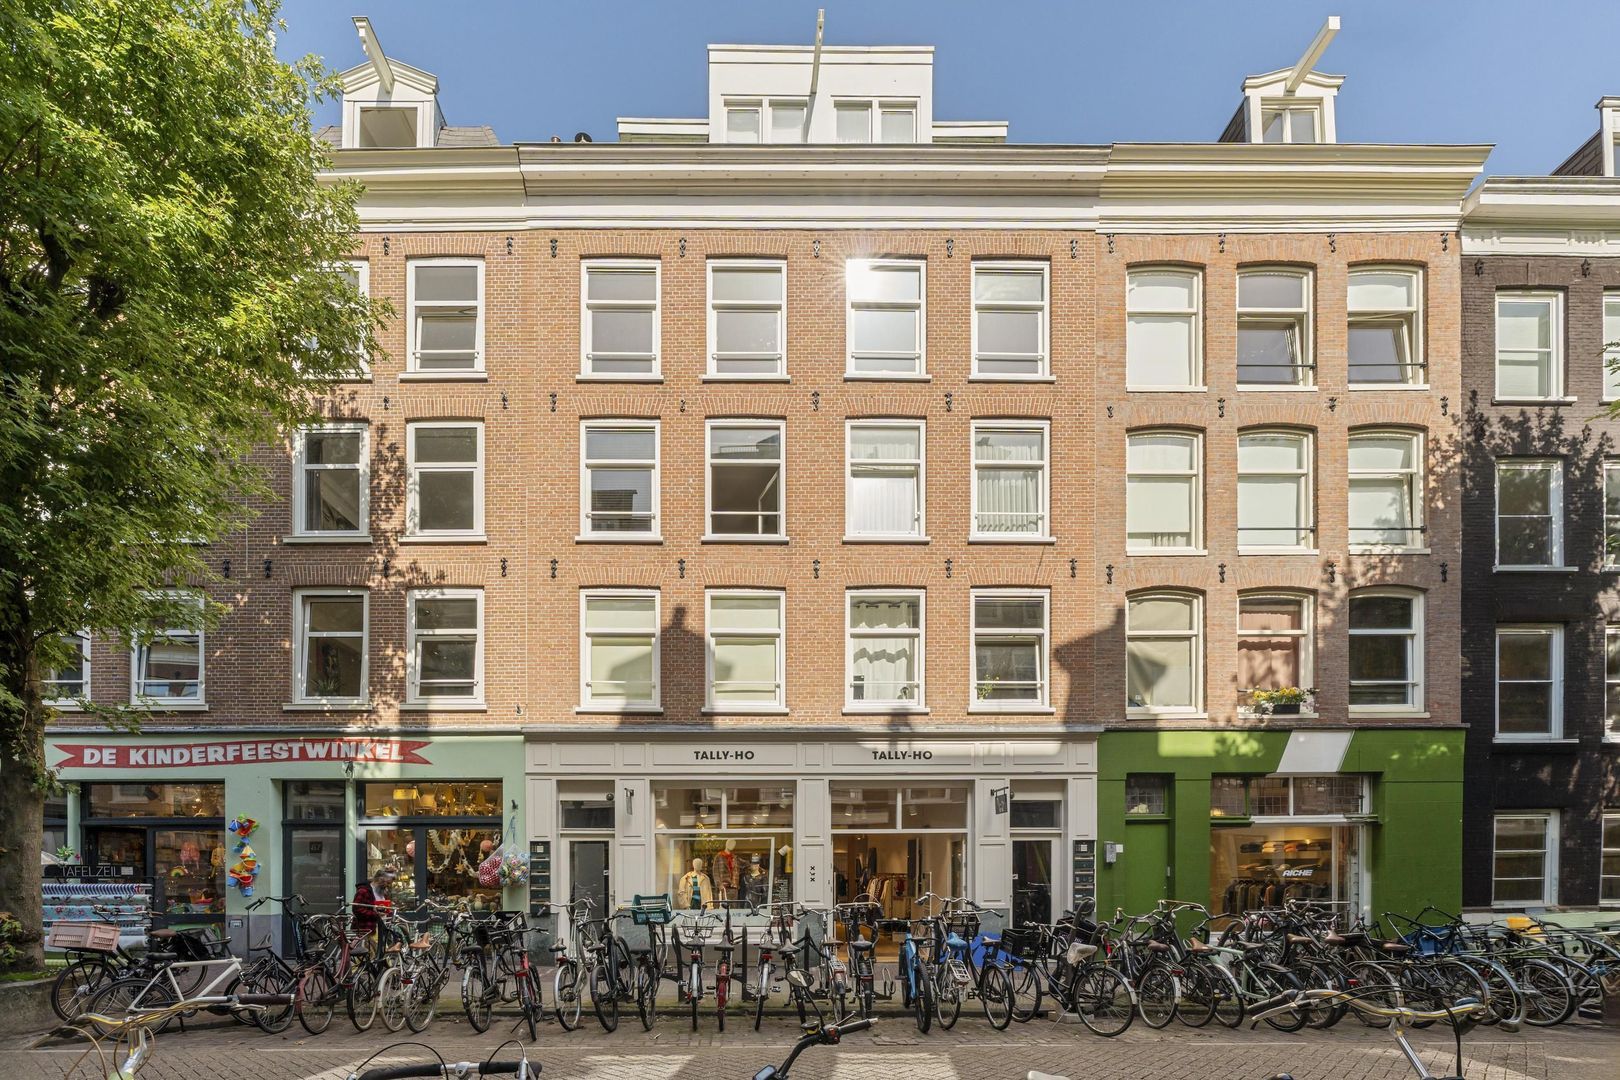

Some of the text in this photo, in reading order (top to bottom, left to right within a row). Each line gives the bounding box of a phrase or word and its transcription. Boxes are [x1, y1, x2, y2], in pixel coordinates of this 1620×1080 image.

[83, 742, 403, 766] DE KINDERFEESTWINKEL
[693, 750, 755, 760] TALLY-HO
[872, 750, 933, 760] TALLY-HO
[62, 866, 121, 877] TAFELZEIL
